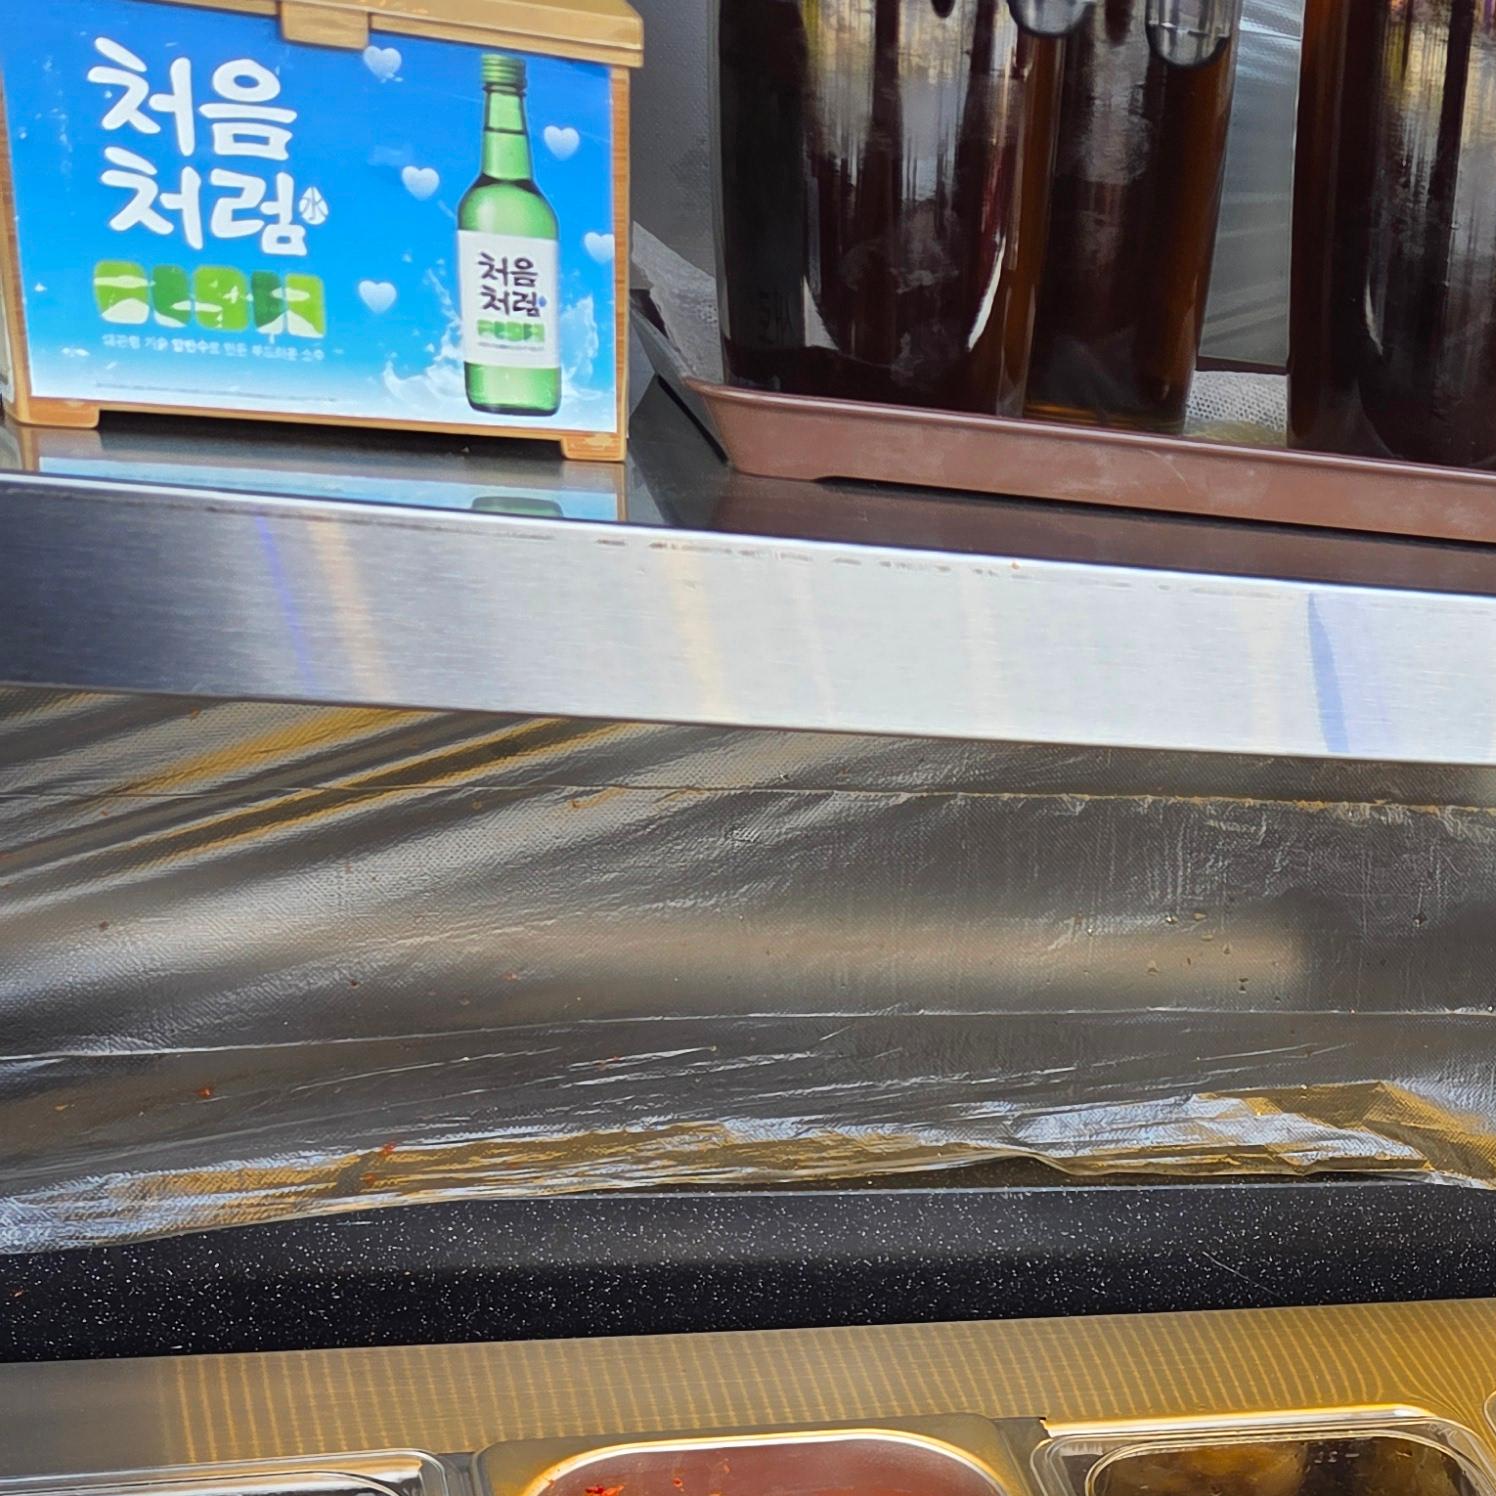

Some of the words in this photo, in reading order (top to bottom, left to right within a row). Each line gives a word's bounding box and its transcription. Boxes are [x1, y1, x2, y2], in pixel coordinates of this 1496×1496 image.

[87, 37, 297, 161] 처음
[101, 146, 307, 256] 처럼
[478, 252, 538, 287] 처음
[480, 284, 540, 317] 처럼
